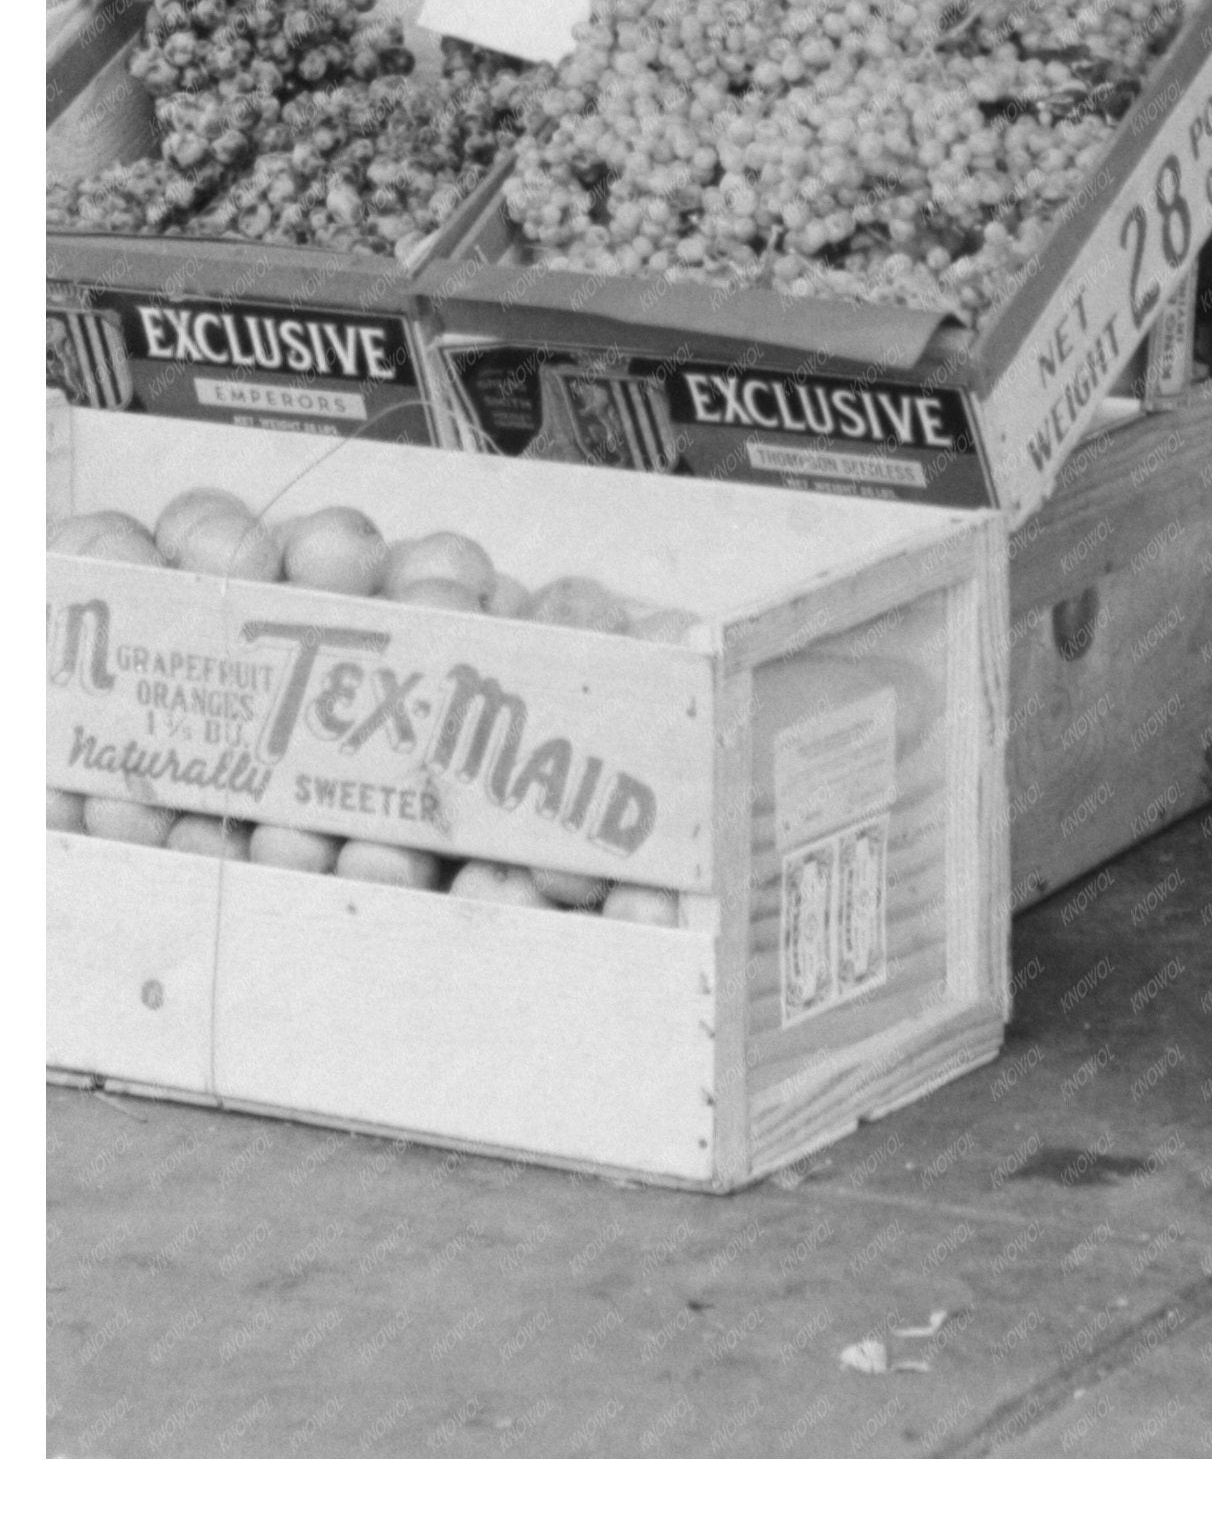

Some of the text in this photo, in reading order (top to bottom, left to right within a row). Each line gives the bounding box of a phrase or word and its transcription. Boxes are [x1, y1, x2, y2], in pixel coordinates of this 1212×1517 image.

[1119, 154, 1192, 331] 28
[135, 305, 396, 380] EXCLUSIVE
[1036, 288, 1089, 389] NET
[214, 386, 348, 414] EMPERORS
[684, 373, 954, 447] EXCLUSIVE
[1026, 313, 1121, 473] WEIGHT
[116, 642, 274, 693] GRAPEFRUIT
[136, 680, 254, 723] ORANGES
[294, 772, 442, 822] SWEETER
